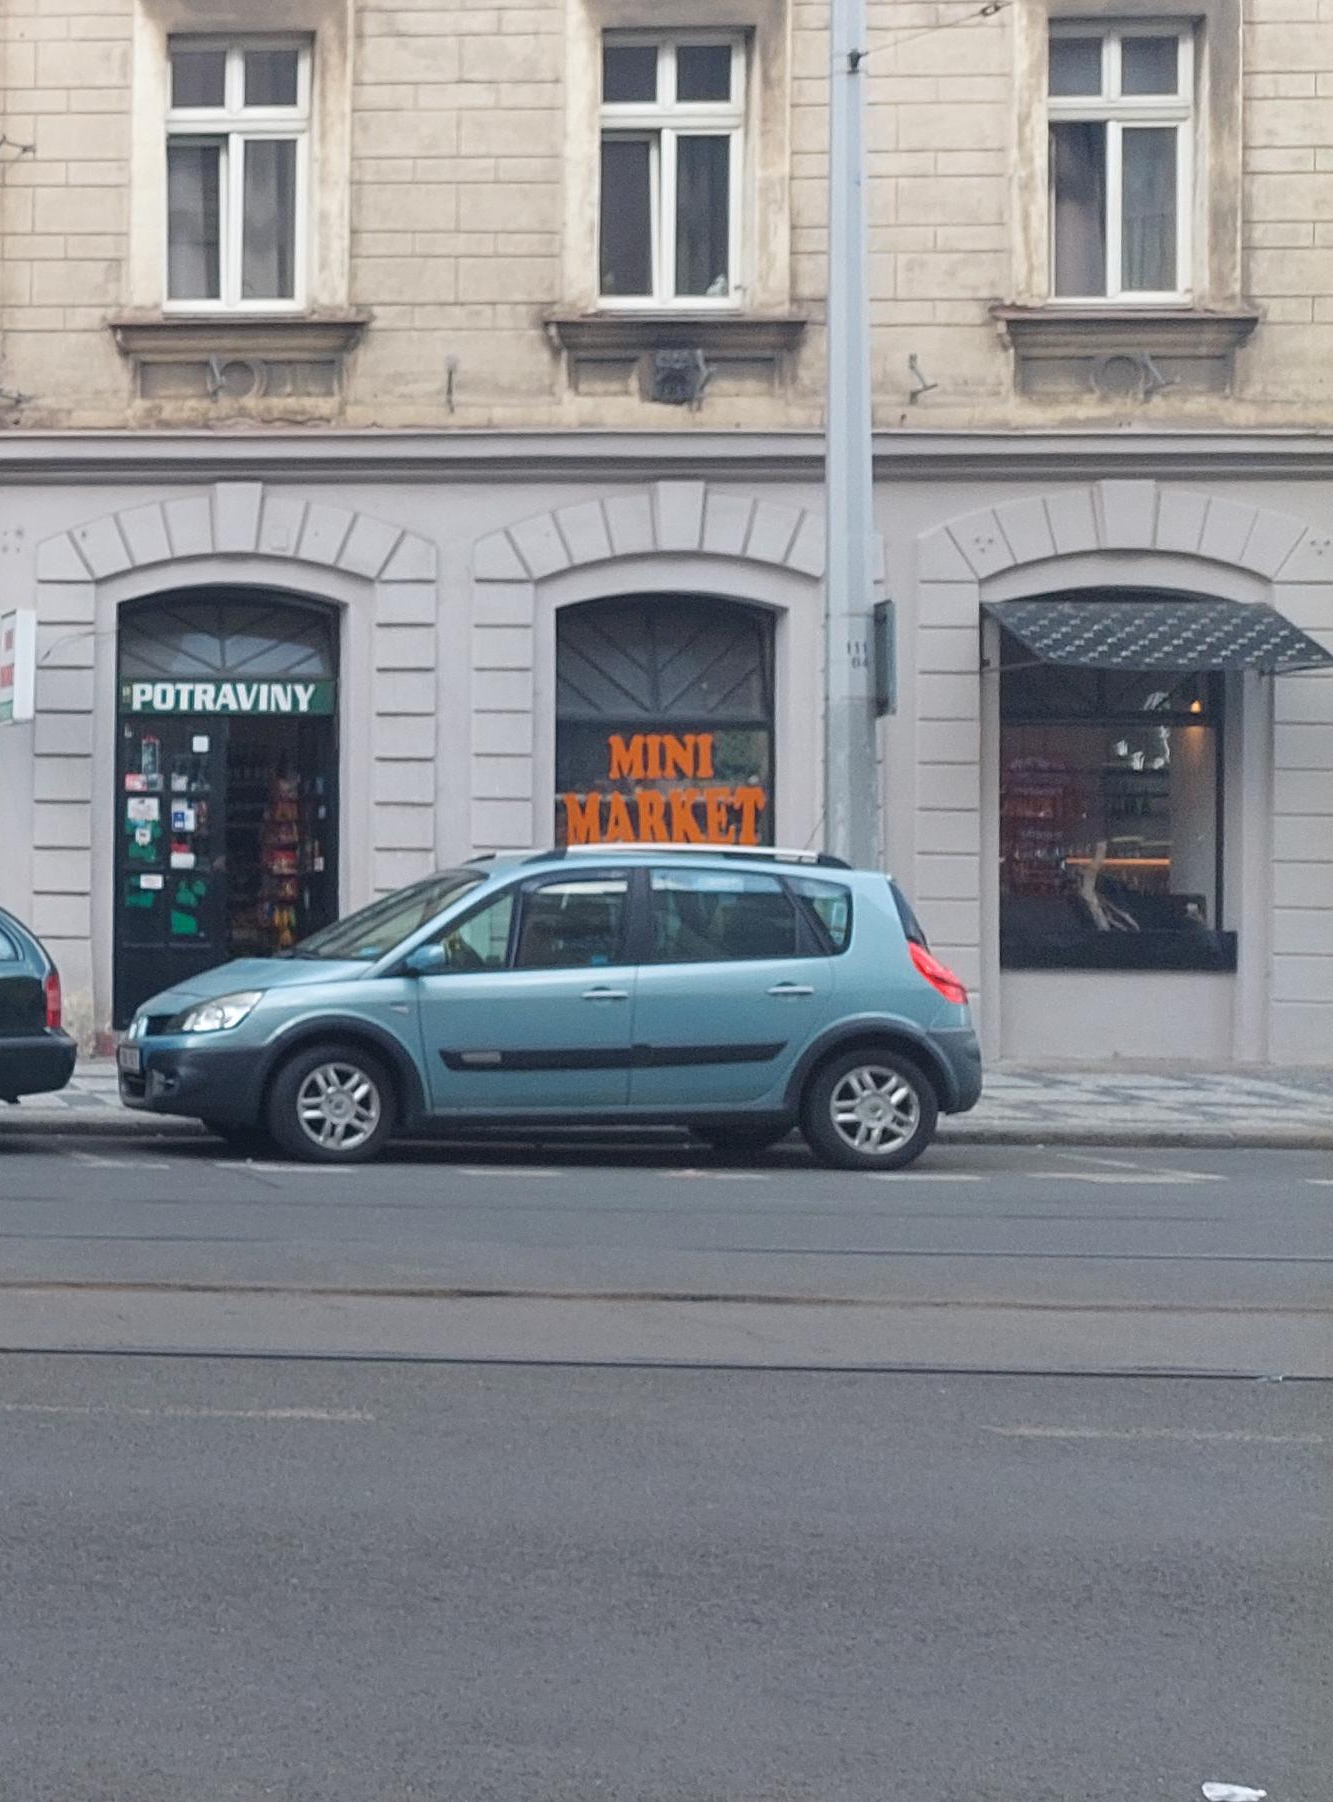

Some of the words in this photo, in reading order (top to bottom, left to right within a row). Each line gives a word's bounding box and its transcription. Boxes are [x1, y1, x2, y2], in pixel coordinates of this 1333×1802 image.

[131, 682, 317, 713] POTRAVINY
[608, 732, 714, 780] MINI
[564, 785, 767, 845] MARKET
